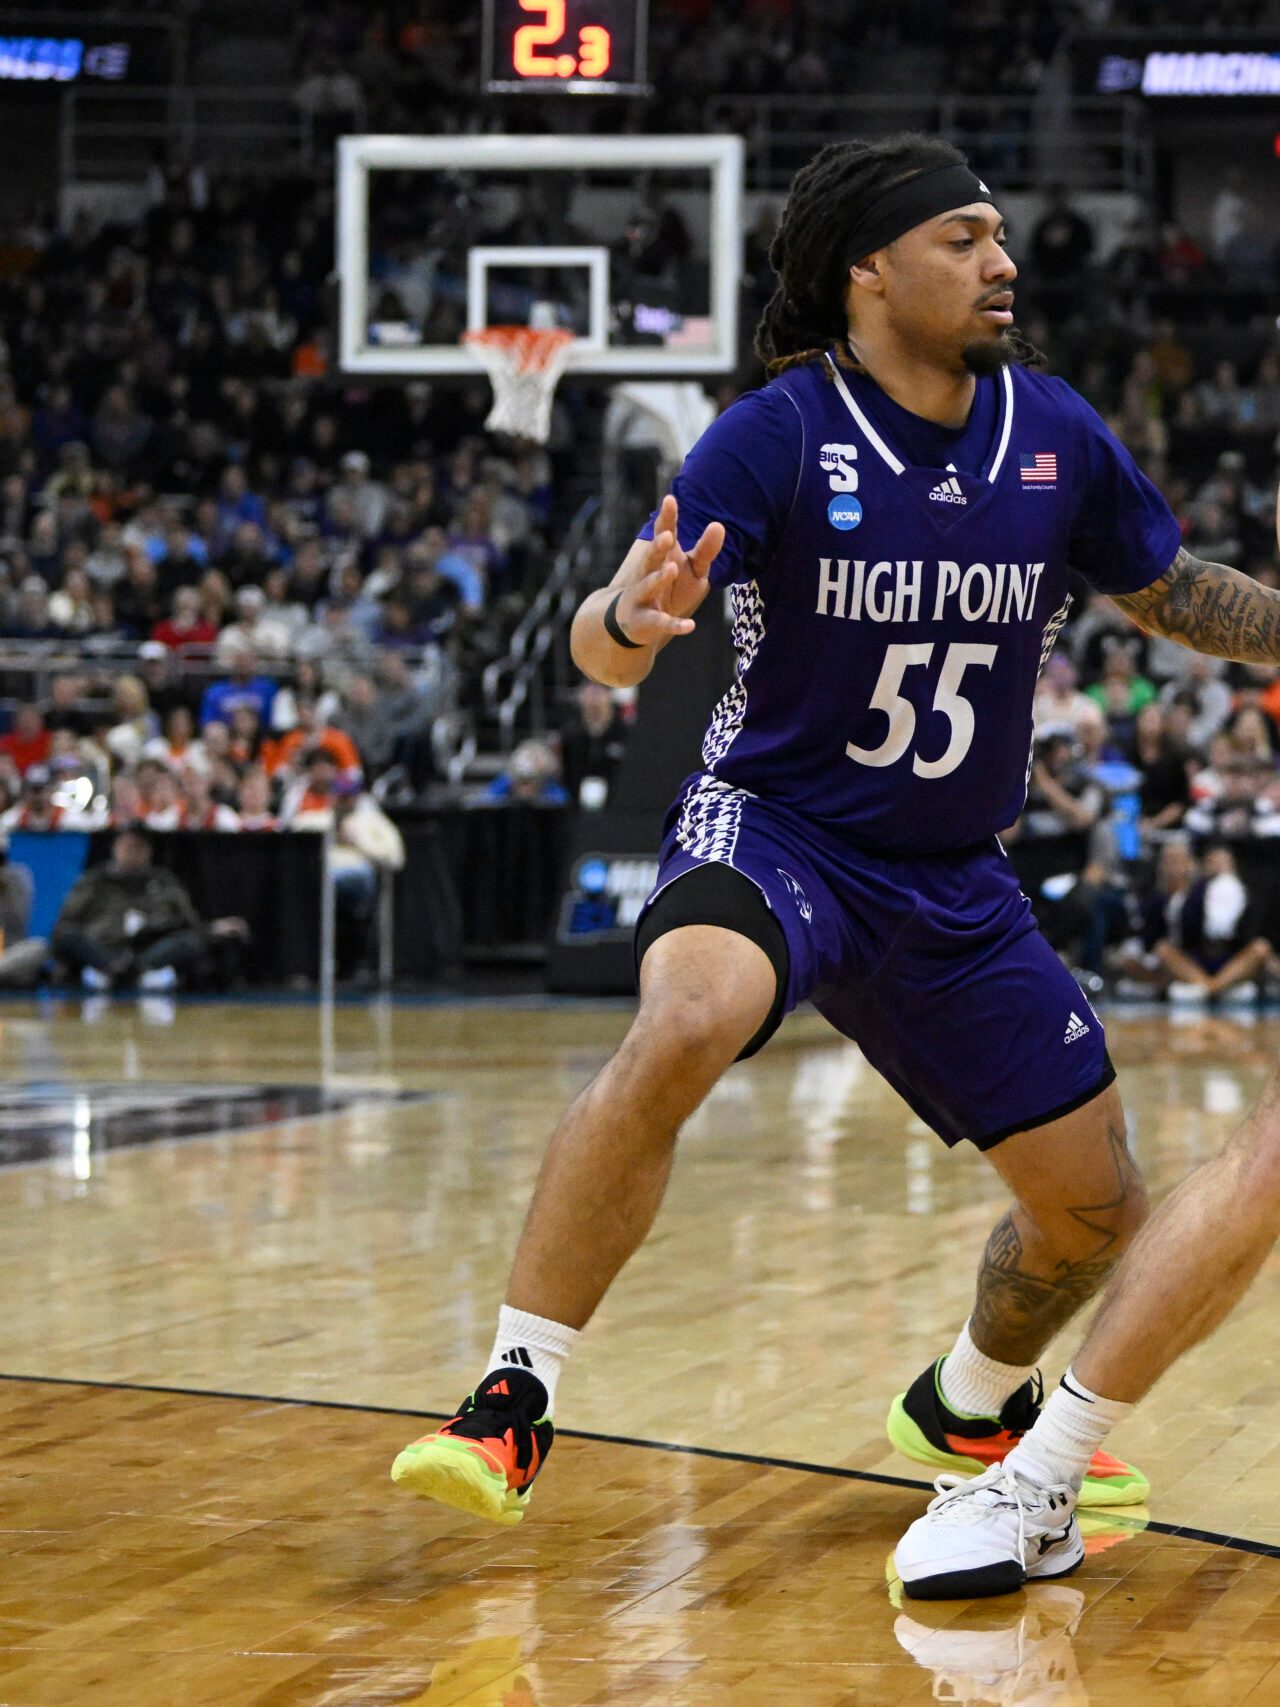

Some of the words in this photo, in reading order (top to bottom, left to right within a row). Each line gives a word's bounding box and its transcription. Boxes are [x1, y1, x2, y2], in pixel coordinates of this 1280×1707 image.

[513, 0, 610, 78] 2.3
[832, 511, 860, 522] NCAA
[929, 490, 968, 506] adidas
[815, 557, 924, 623] HIGH
[932, 560, 1046, 624] POINT
[845, 642, 999, 780] 55
[1064, 1024, 1090, 1045] adidas
